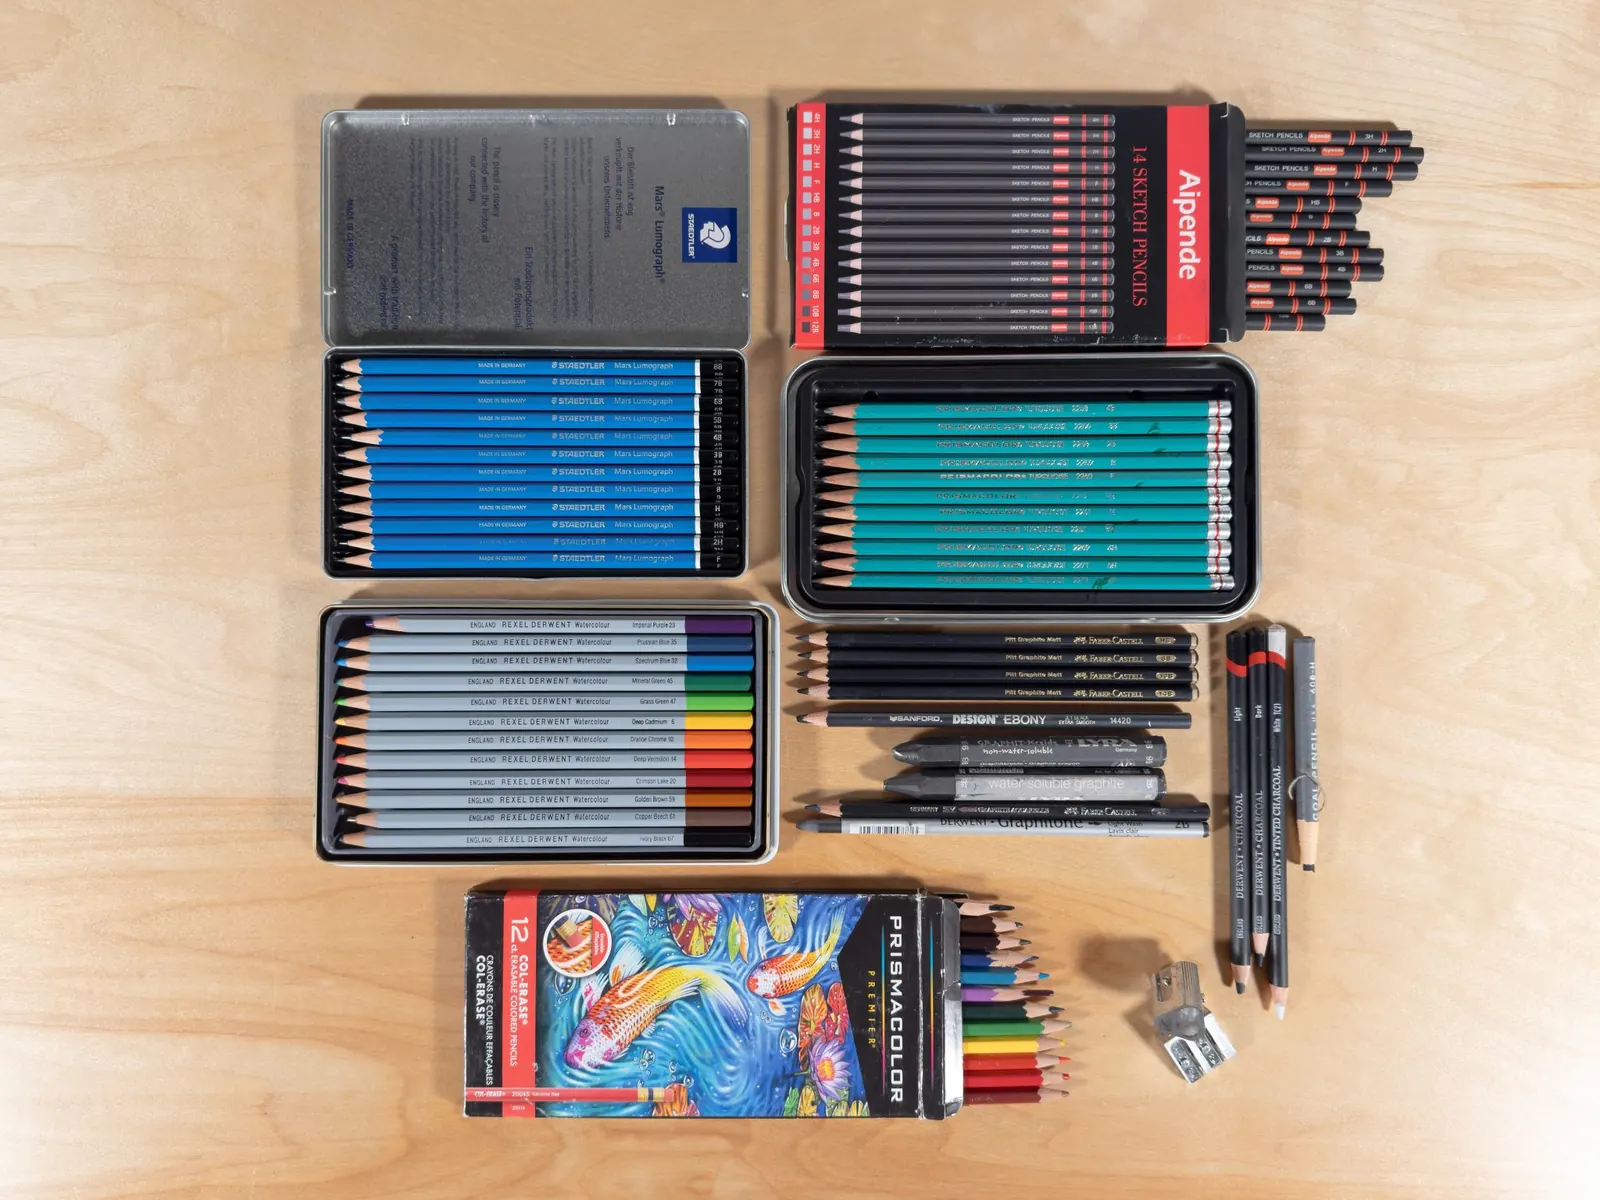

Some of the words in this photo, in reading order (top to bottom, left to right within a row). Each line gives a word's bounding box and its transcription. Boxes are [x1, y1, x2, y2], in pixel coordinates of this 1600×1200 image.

[813, 129, 820, 139] 3H
[813, 144, 820, 154] 2H
[1132, 146, 1148, 163] 14
[813, 192, 820, 203] HB
[1132, 167, 1148, 233] SKETCH
[1173, 170, 1200, 280] Aipende
[813, 226, 820, 235] 2B
[813, 258, 819, 267] 4B
[1132, 239, 1148, 307] PENCILS
[633, 362, 673, 370] Lumograph
[633, 450, 673, 459] Lumograph
[633, 468, 673, 477] Lumograph
[633, 504, 673, 512] Lumograph
[575, 621, 610, 629] Watercolour
[1088, 636, 1143, 644] FABER-CASTELL
[1089, 655, 1144, 663] FABER-CASTELL
[573, 677, 608, 685] Watercolour
[1089, 672, 1144, 680] FABER-CASTELL
[1088, 690, 1143, 698] FABER-CASTELL
[1255, 704, 1263, 718] Dark
[574, 718, 609, 726] Watercolour
[1003, 715, 1047, 725] EBONY
[1110, 716, 1131, 724] 14420
[983, 747, 1053, 755] non-water-soluble
[575, 755, 611, 763] Watercolour
[988, 779, 1070, 789] water-soluble
[1074, 777, 1125, 791] graphite
[1272, 765, 1281, 816] CHARCOAL
[573, 796, 608, 804] Watercolour
[574, 813, 609, 821] Watercolour
[1235, 793, 1243, 845] CHARCOAL
[1255, 790, 1263, 842] CHARCOAL
[1272, 818, 1281, 851] TINTED
[1236, 854, 1244, 899] DERWENT
[1273, 856, 1281, 902] DERWENT
[511, 917, 529, 942] 12
[486, 955, 494, 992] CRAYONS
[476, 955, 486, 1026] COL-ERASE®
[519, 955, 528, 1025] COL-ERASE®
[486, 993, 494, 1003] DE
[890, 915, 903, 1102] PRISMACOLOR
[485, 1042, 493, 1085] EFFAÇABLES
